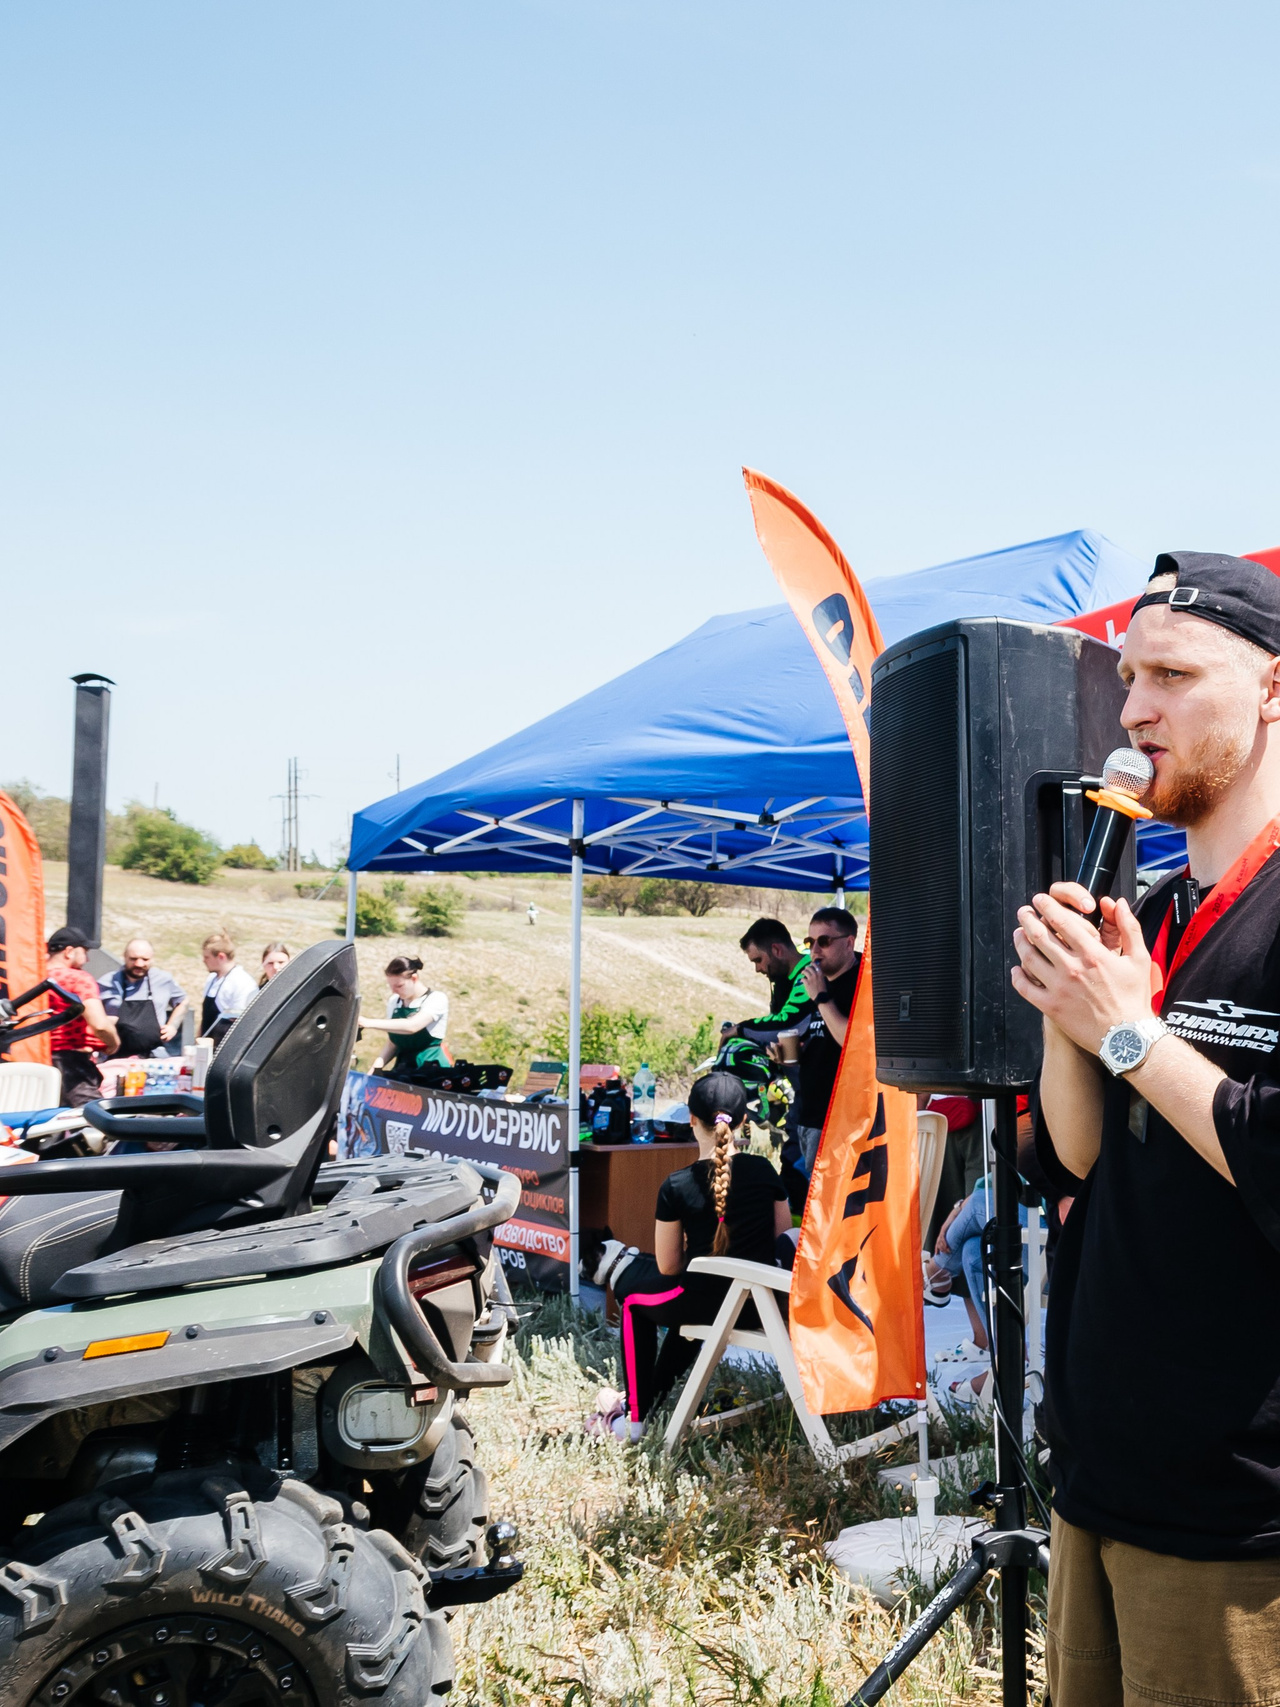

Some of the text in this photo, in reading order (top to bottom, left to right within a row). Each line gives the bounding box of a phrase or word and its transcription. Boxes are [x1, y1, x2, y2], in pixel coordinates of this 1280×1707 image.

[1166, 1011, 1279, 1043] SHARMAX
[1229, 1037, 1276, 1053] RACE
[421, 1098, 562, 1154] МОТОСЕРВИС
[493, 1223, 567, 1255] ИЗВОДСТВО
[192, 1588, 306, 1637] WILD THANG
